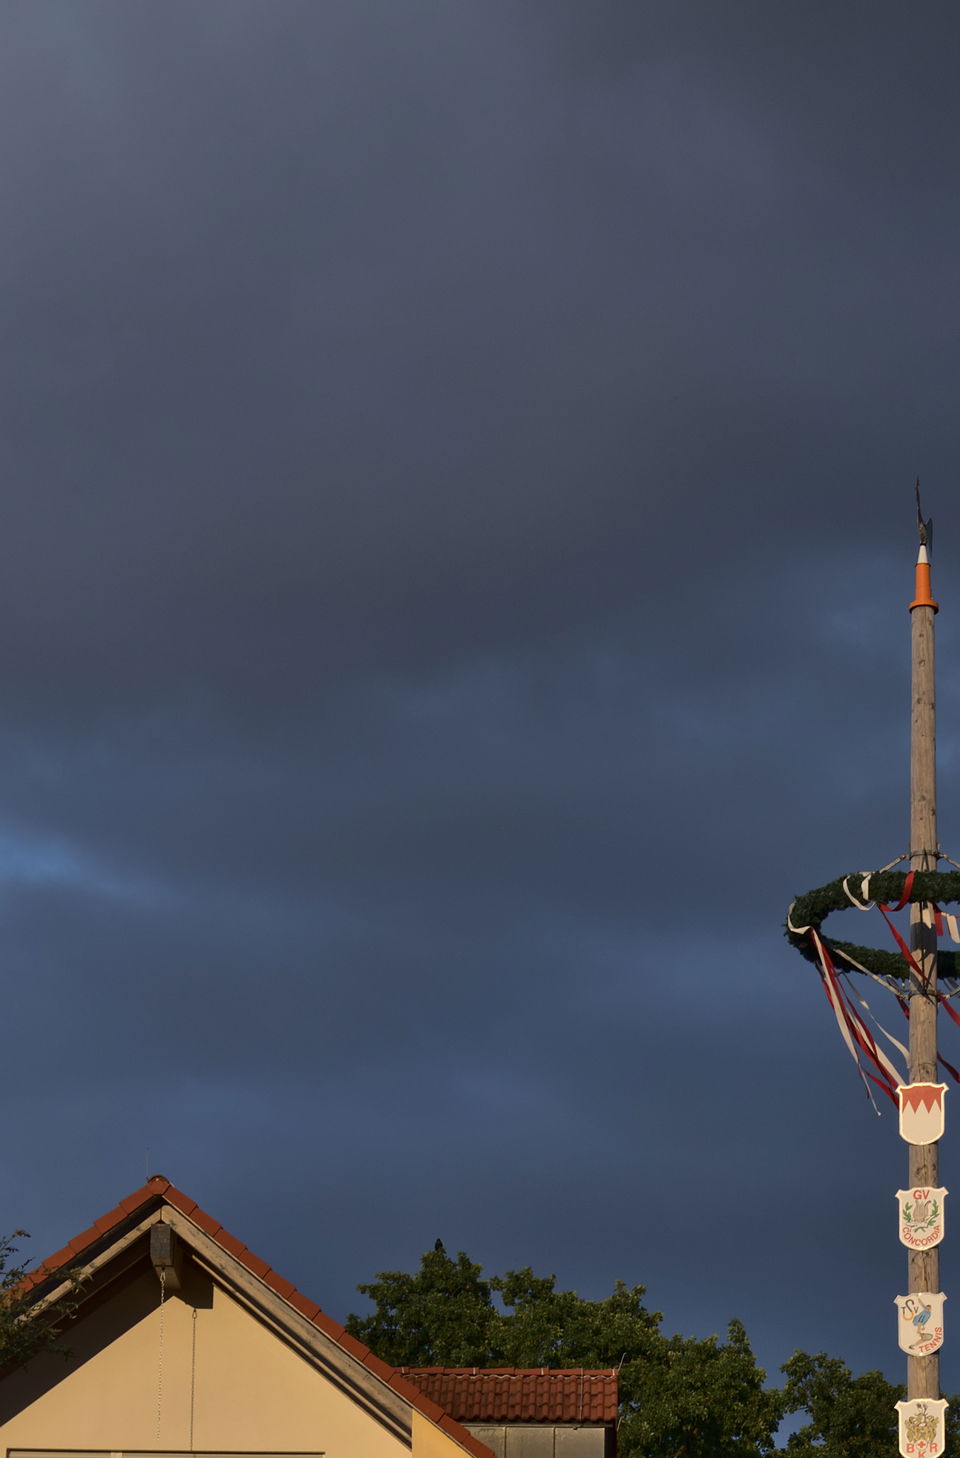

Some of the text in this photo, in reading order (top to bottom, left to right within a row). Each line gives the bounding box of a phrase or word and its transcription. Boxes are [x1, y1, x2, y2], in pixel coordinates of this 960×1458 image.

[913, 1189, 930, 1200] GV
[902, 1225, 941, 1246] CONCORDIA
[919, 1326, 942, 1352] TENNIS
